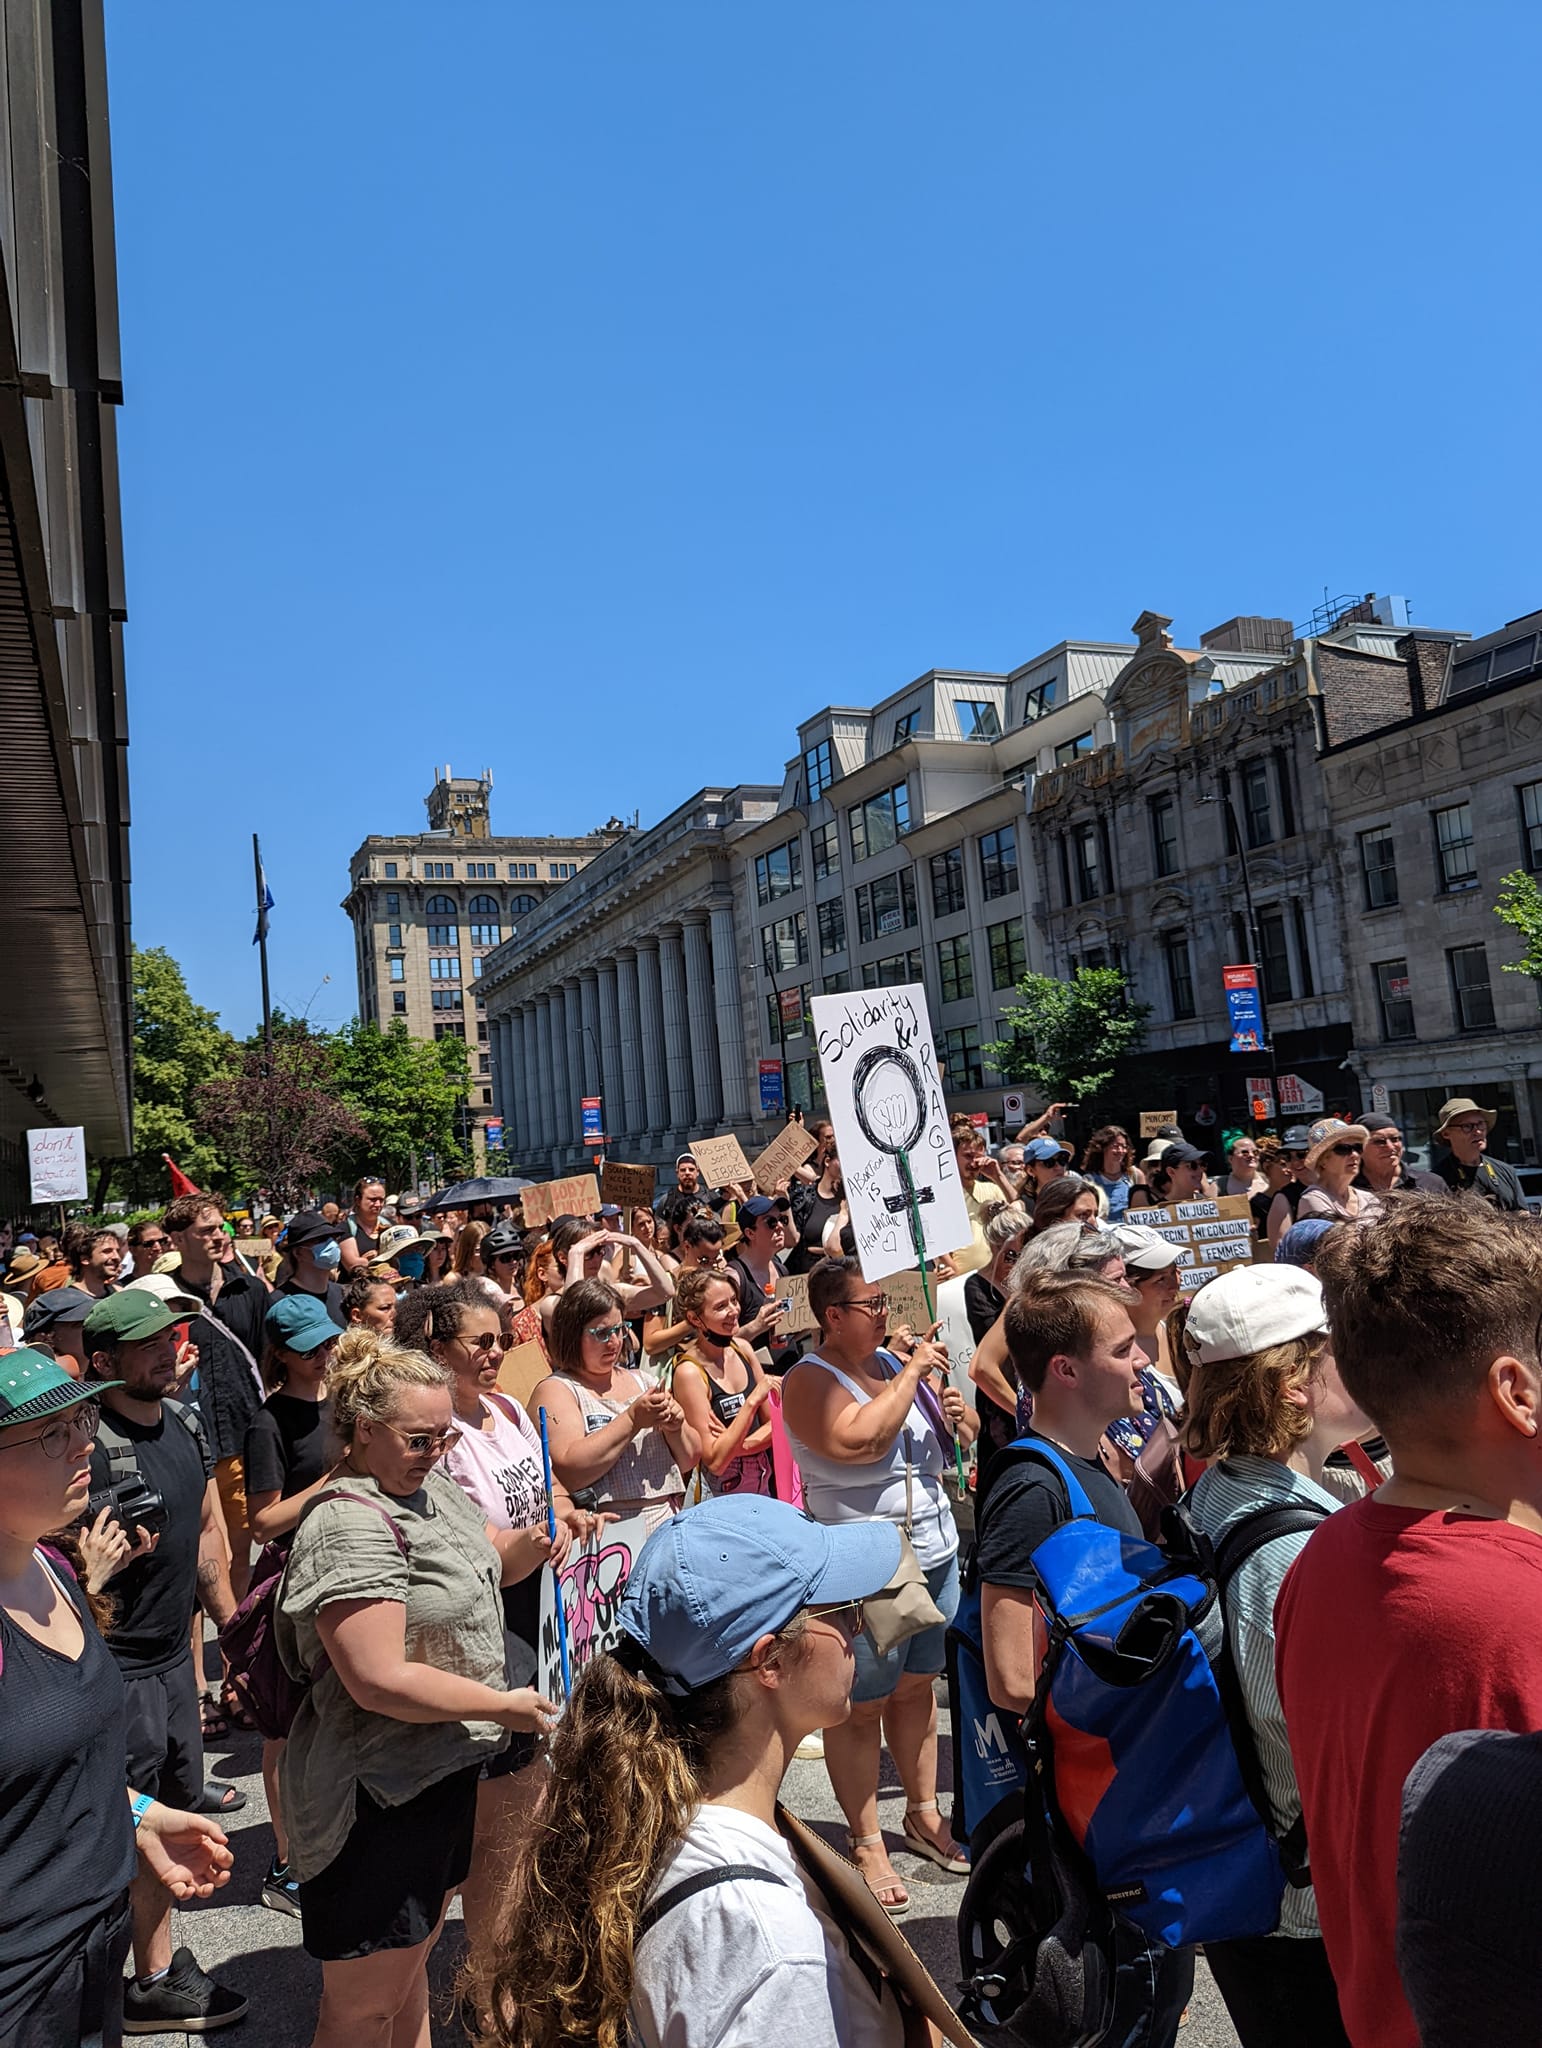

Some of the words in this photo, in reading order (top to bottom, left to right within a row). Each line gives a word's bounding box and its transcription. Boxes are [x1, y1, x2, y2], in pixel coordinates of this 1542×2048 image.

[818, 990, 918, 1063] Solidarity
[895, 1017, 913, 1050] &
[920, 1043, 953, 1181] RAGE
[33, 1132, 75, 1151] don't
[694, 1145, 713, 1157] Nos
[714, 1141, 735, 1152] corps
[793, 1138, 817, 1161] THEM
[711, 1152, 728, 1165] sont
[757, 1136, 799, 1186] STANDING
[707, 1162, 747, 1182] LIBRES
[523, 1187, 545, 1206] MY
[550, 1178, 588, 1201] BODY
[1130, 1213, 1140, 1224] NI
[1143, 1210, 1169, 1224] PAPE.
[1178, 1206, 1190, 1218] NI
[1191, 1203, 1217, 1217] JUGE.
[1195, 1227, 1205, 1238] NI
[1206, 1221, 1248, 1237] CONJOINT
[1205, 1243, 1245, 1260] FEMMES
[788, 1304, 810, 1328] UTE
[1106, 1889, 1140, 1900] FREITAG
